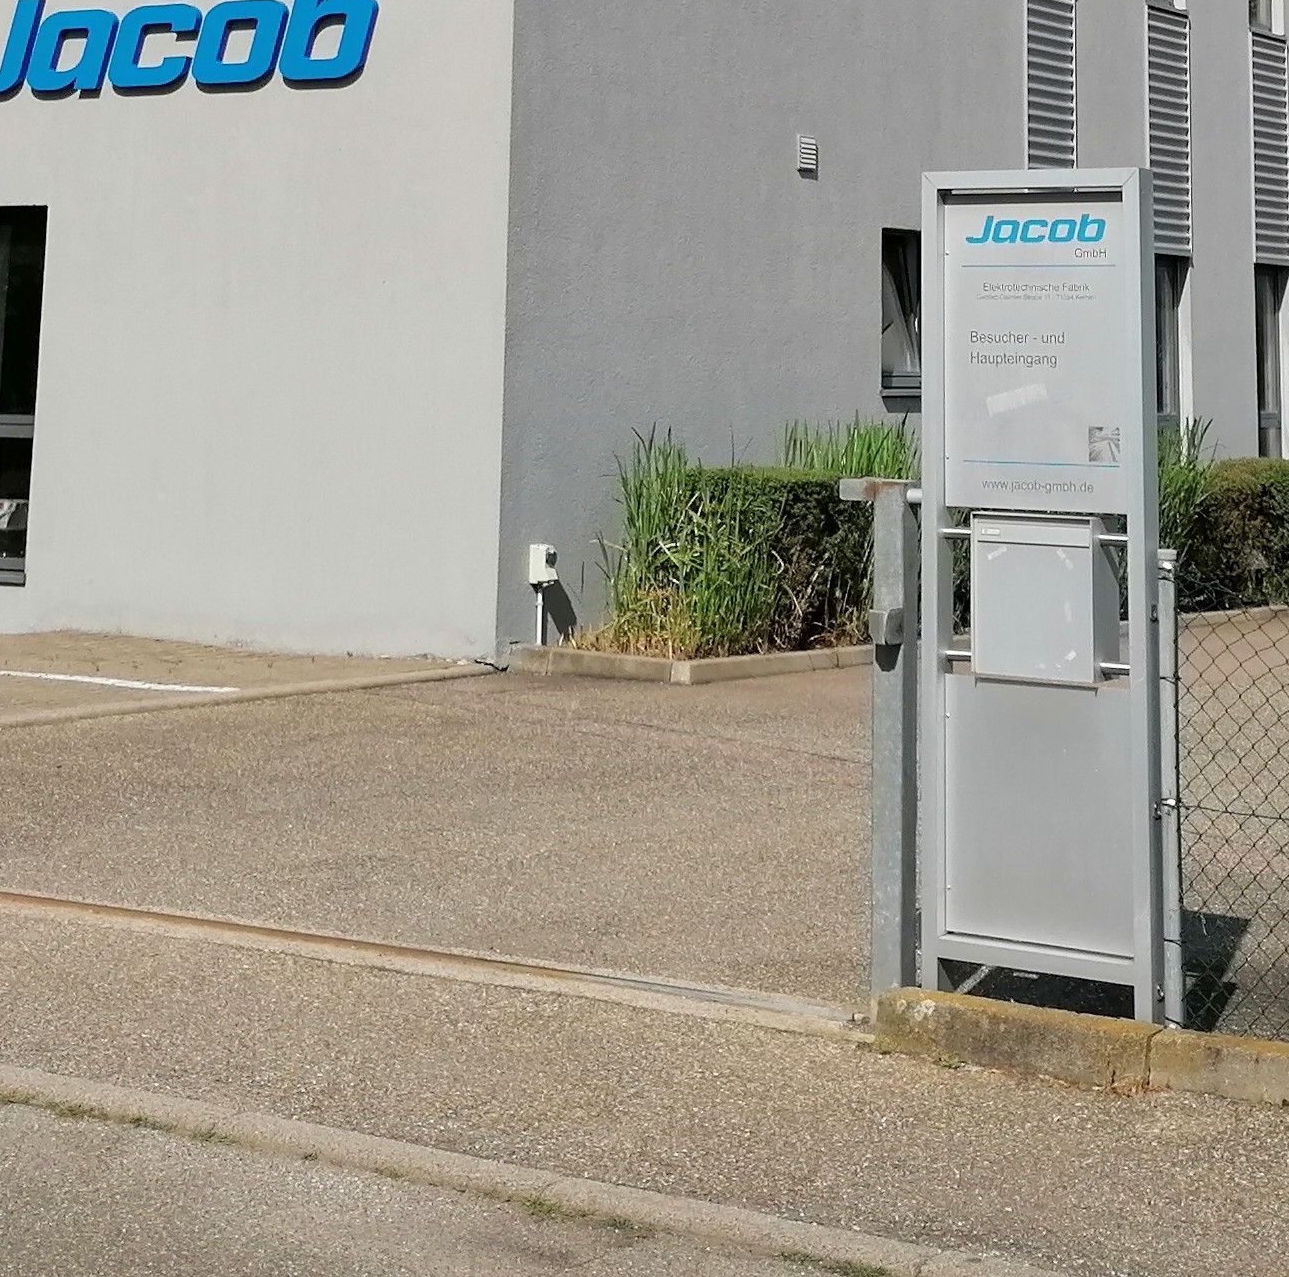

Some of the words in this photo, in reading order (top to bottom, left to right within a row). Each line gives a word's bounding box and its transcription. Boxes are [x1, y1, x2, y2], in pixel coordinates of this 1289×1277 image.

[965, 213, 1107, 244] Jacob
[1074, 247, 1107, 259] GmbH
[1062, 282, 1090, 292] Fabrik
[970, 330, 1029, 344] Besucher
[1041, 331, 1065, 344] und
[970, 351, 1057, 368] Haupteingang
[981, 479, 1095, 494] www.jacob-gmbh.de
